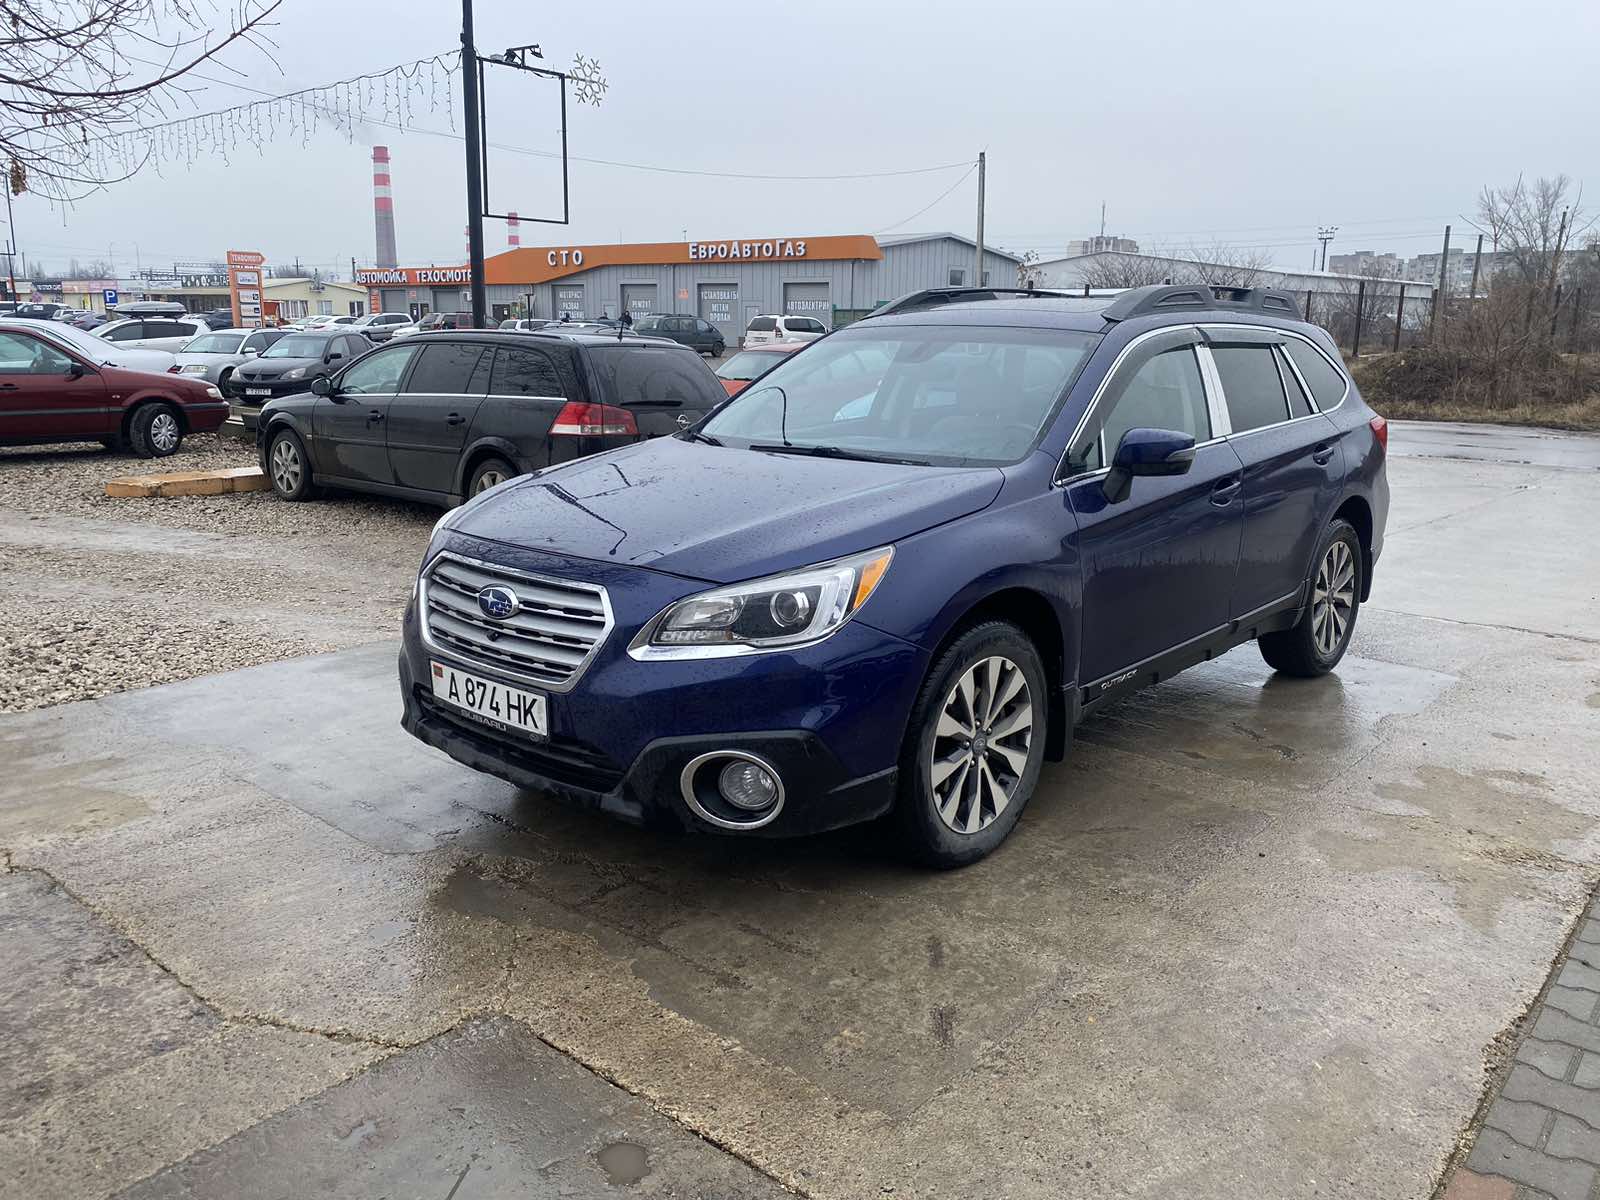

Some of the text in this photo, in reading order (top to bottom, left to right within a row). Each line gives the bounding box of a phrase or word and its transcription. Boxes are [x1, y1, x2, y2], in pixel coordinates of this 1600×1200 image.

[547, 250, 583, 266] СТО
[355, 269, 408, 283] АВТОМОЙКА
[448, 672, 539, 730] A 874 HK
[460, 709, 507, 732] SUBARU
